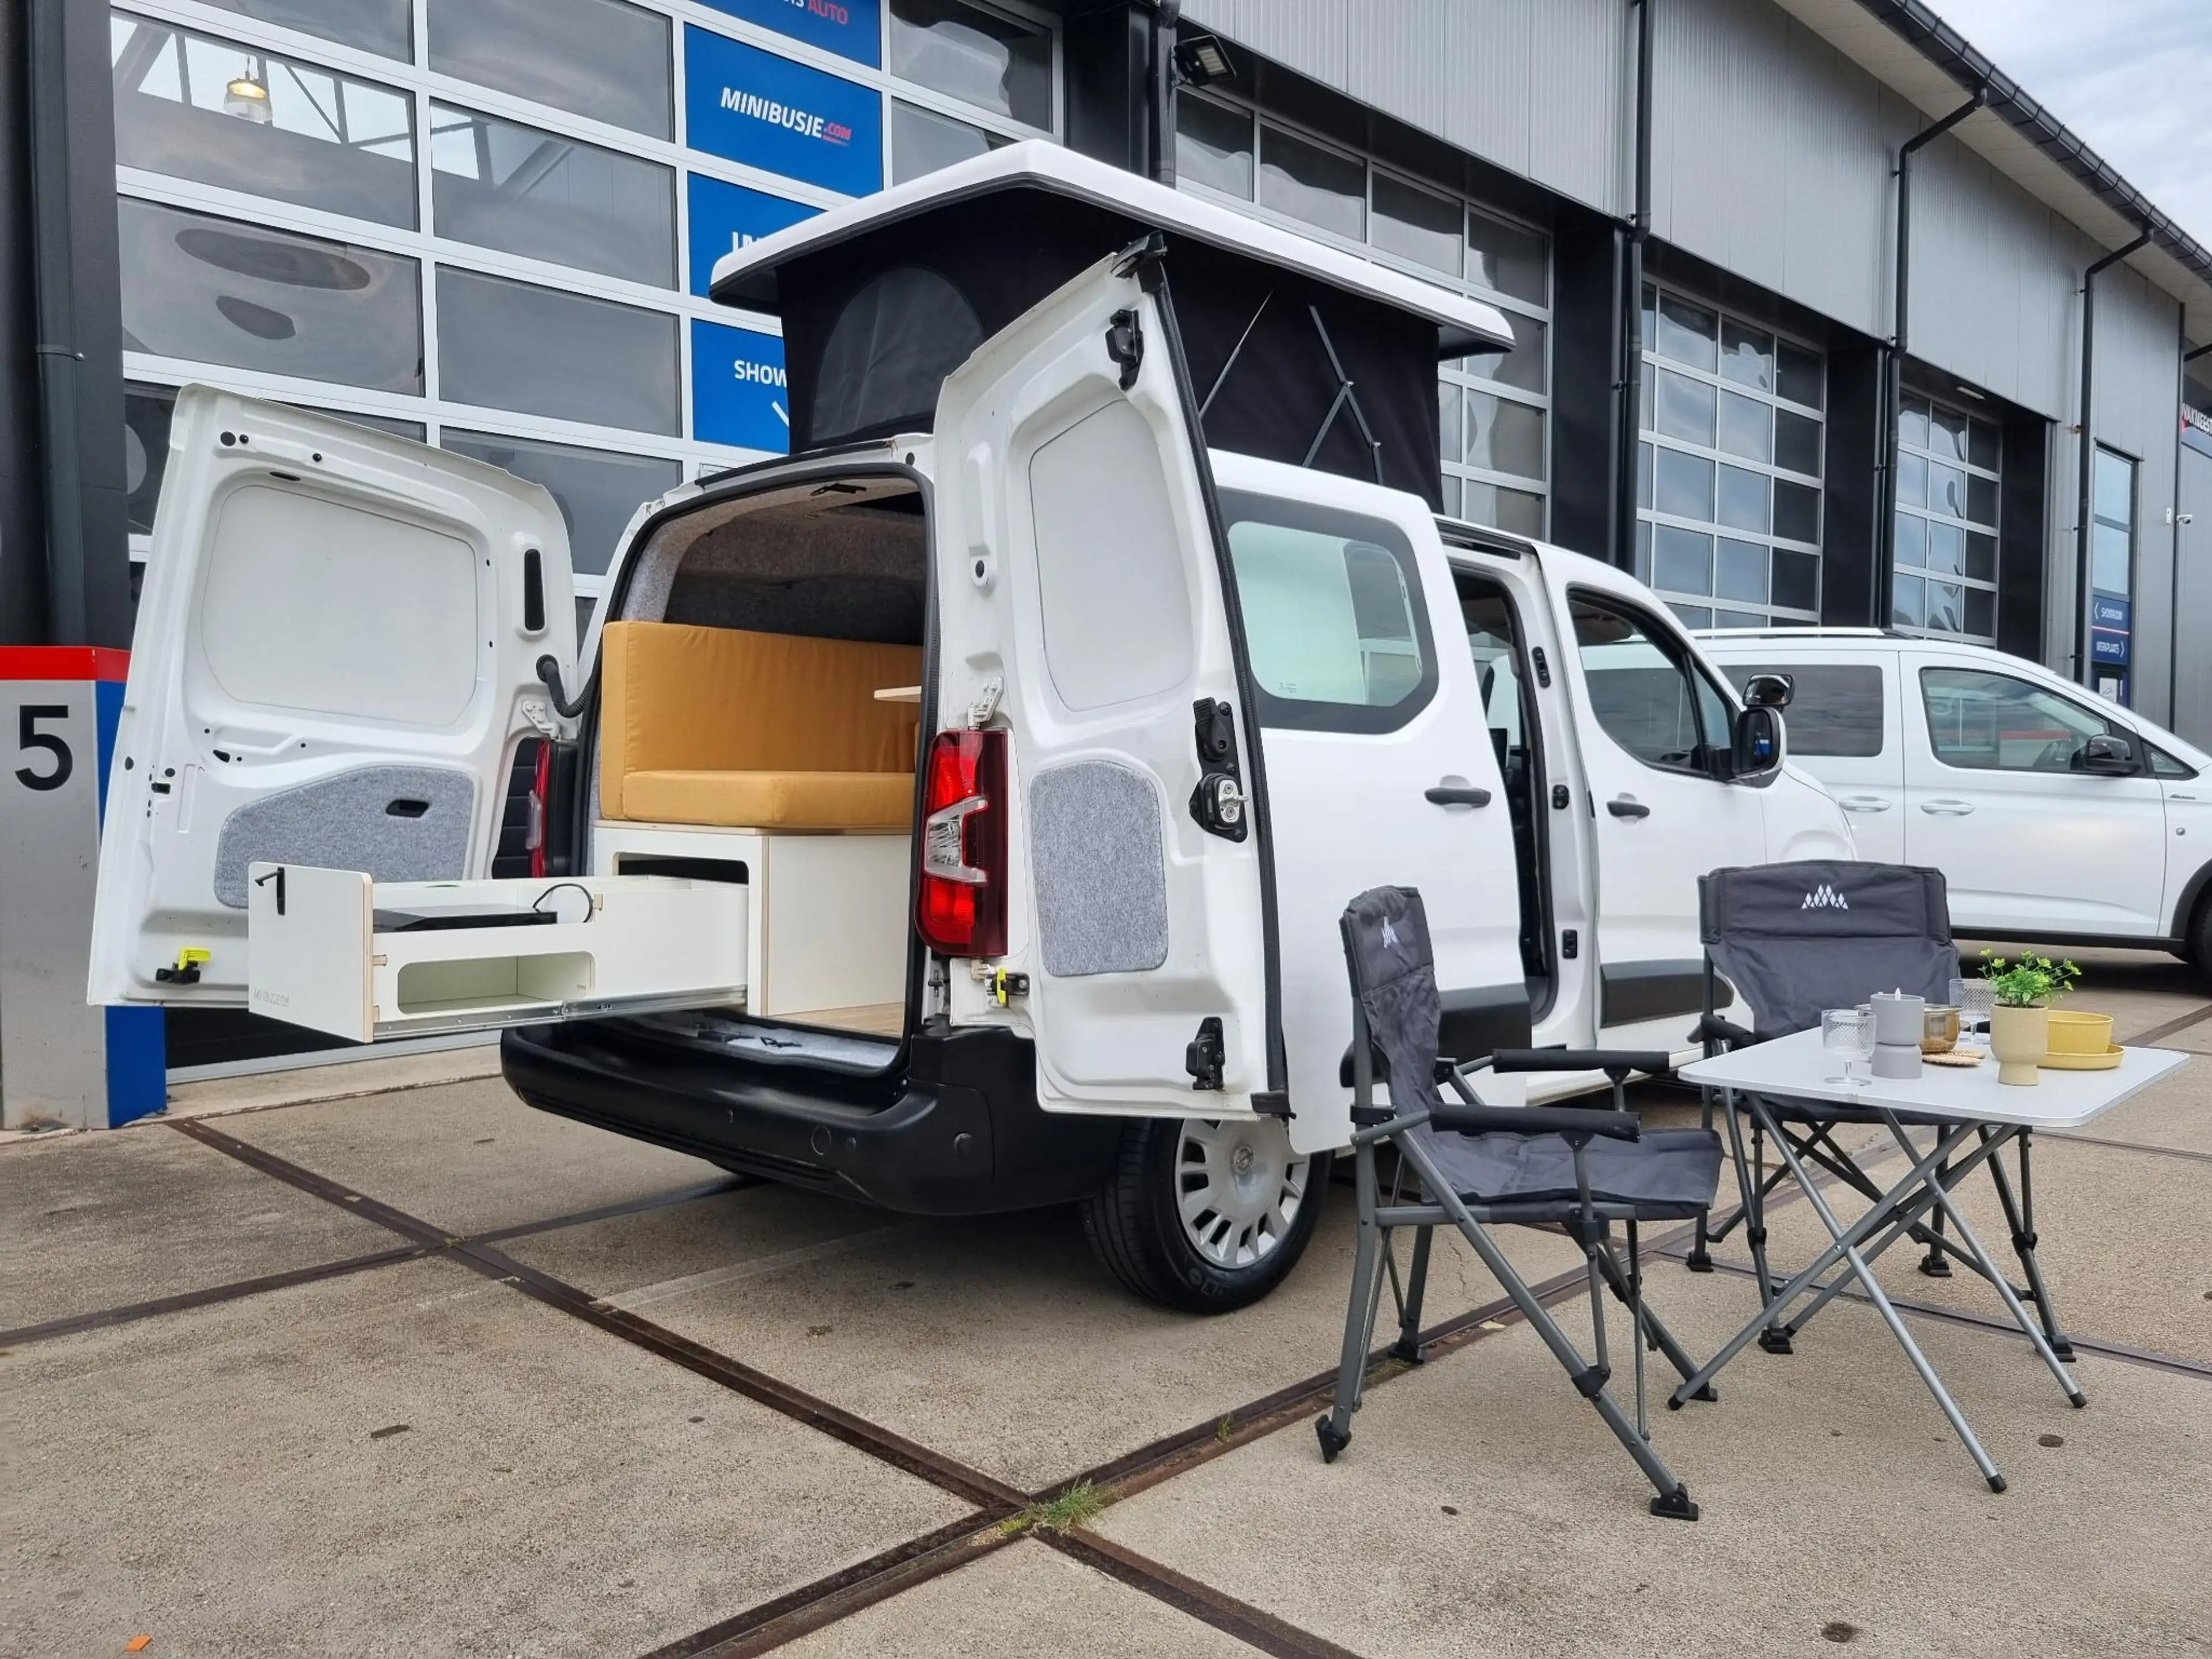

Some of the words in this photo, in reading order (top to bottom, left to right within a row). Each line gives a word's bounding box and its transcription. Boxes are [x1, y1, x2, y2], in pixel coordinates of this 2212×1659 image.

[808, 0, 848, 25] AUTO
[734, 359, 787, 388] SHOW
[15, 705, 73, 791] 5
